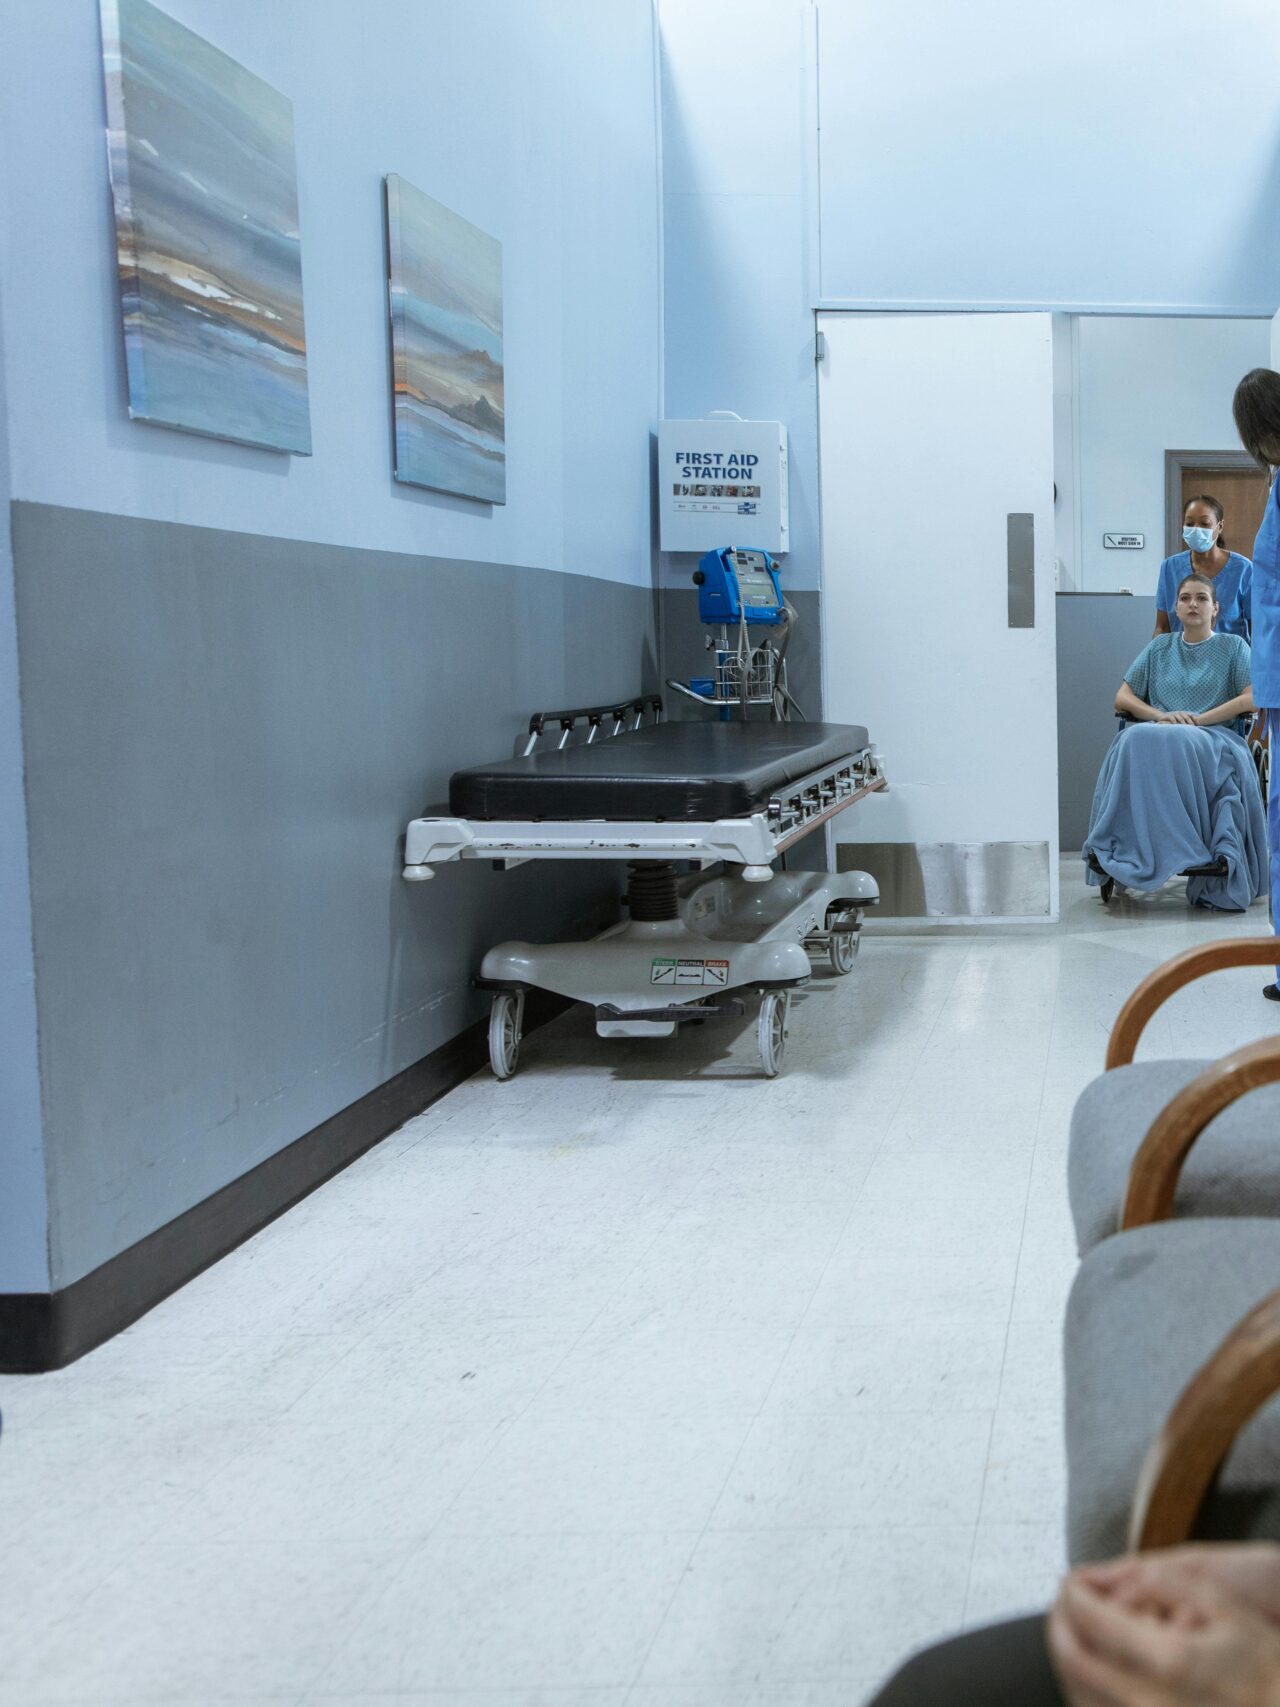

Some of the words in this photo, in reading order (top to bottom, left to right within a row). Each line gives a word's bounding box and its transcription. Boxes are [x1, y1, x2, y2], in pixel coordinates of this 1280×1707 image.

[675, 452, 723, 465] FIRST
[727, 453, 759, 466] AID
[682, 466, 753, 479] STATION
